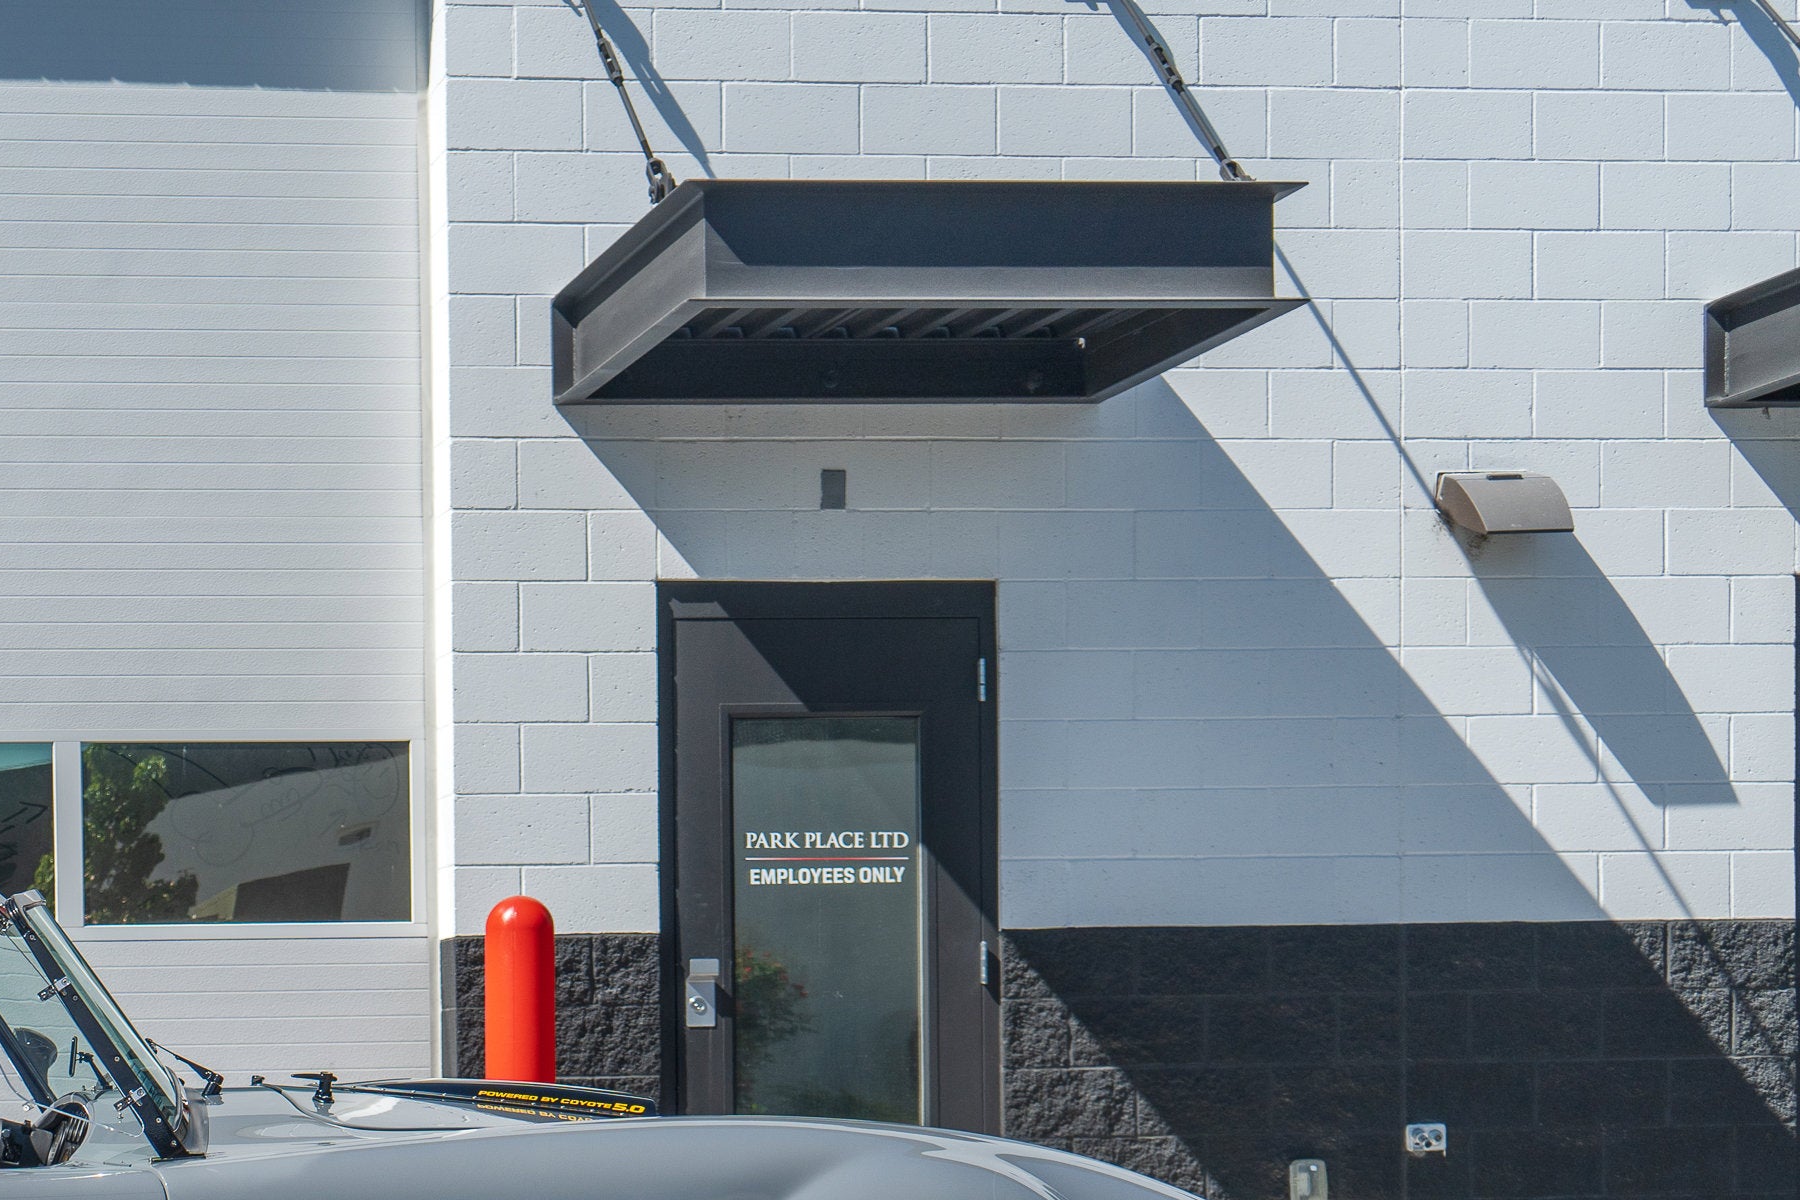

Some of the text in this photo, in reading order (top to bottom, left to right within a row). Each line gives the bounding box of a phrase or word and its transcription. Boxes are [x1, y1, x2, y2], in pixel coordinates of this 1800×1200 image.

[745, 832, 909, 849] PARK PLACE LTD
[750, 866, 906, 885] EMPLOYEES ONLY
[478, 1090, 538, 1101] POWERED
[560, 1098, 612, 1109] COYOTE
[612, 1103, 646, 1114] 5.0
